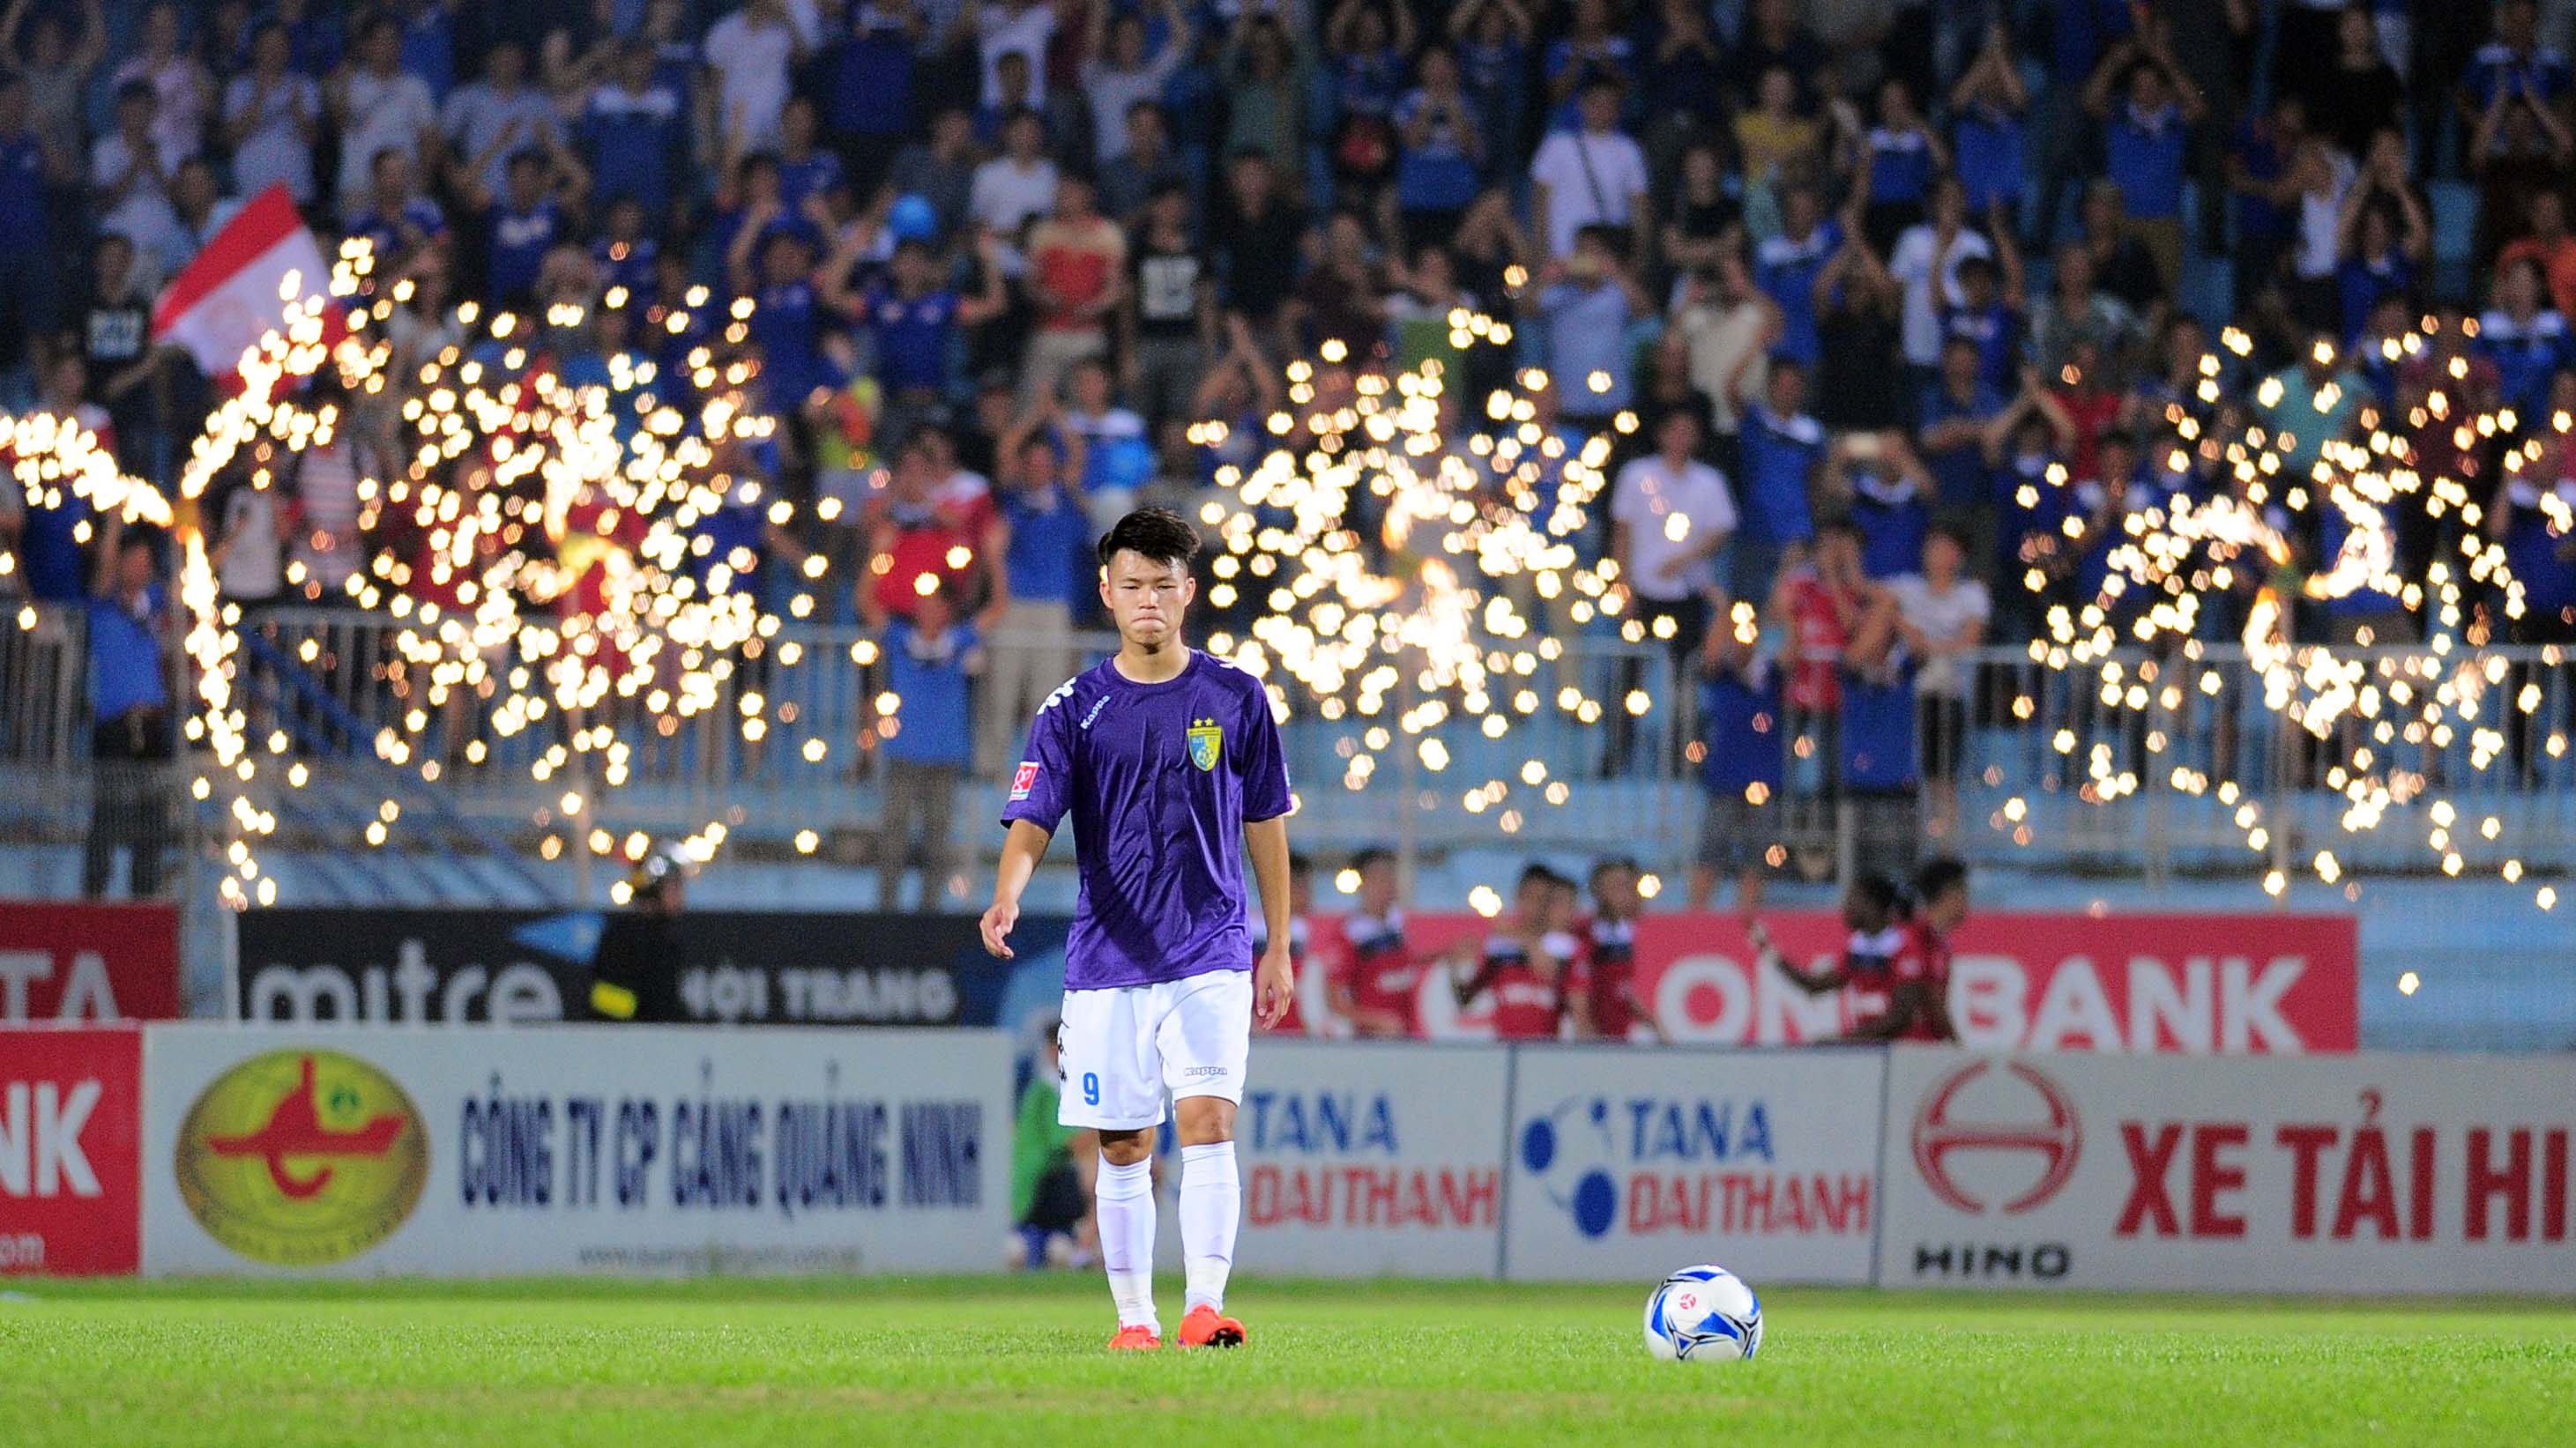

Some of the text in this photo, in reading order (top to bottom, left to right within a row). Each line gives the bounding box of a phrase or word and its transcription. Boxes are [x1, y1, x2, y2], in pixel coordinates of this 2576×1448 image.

[1080, 695, 1111, 730] Kappa
[250, 938, 564, 1025] mitre
[1083, 1072, 1100, 1106] 9
[617, 1098, 660, 1207] CP
[1248, 1091, 1398, 1156] TANA
[1627, 1098, 1776, 1163] TANA
[1249, 1165, 1498, 1229] DAITHANH
[2115, 1087, 2569, 1244] XE TẢI HI
[1628, 1173, 1871, 1236] DAITHANH
[1914, 1244, 2072, 1280] HINO
